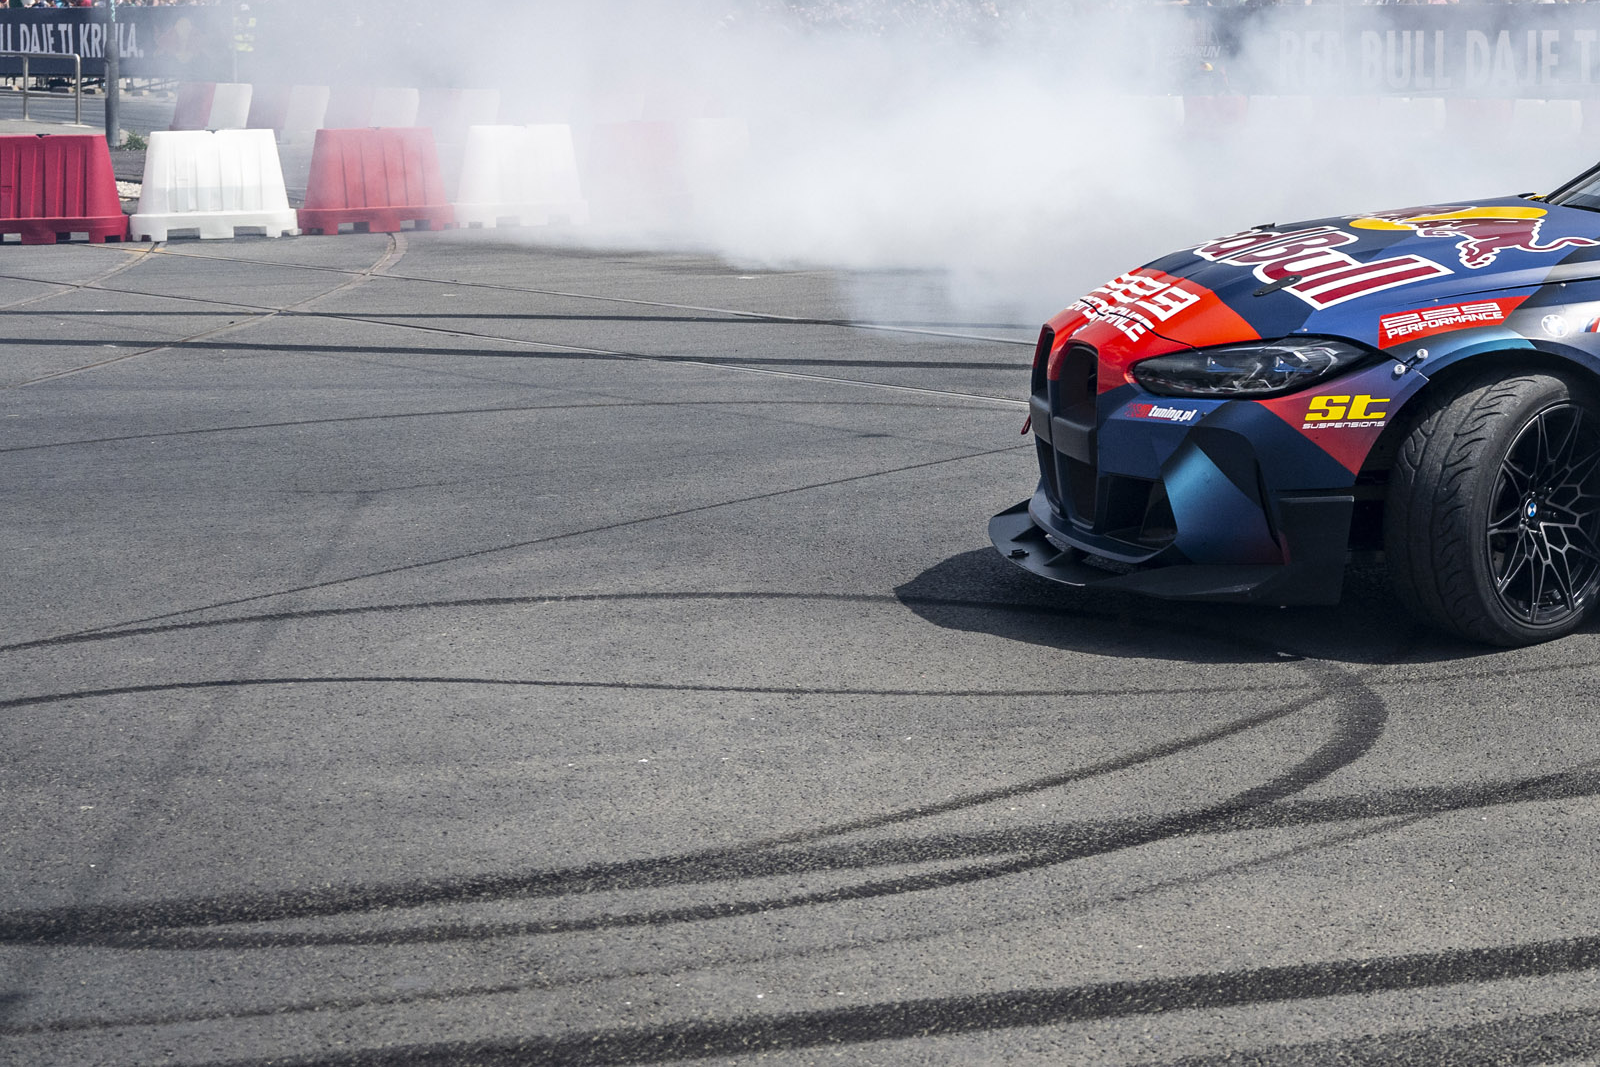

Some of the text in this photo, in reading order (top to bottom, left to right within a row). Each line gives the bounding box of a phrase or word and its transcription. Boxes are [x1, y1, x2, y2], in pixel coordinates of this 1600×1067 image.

[20, 23, 56, 54] DAJE
[57, 23, 74, 55] TI
[1361, 30, 1451, 88] BULL
[1466, 30, 1559, 86] DAJE
[1386, 311, 1505, 339] PERFORMANCE
